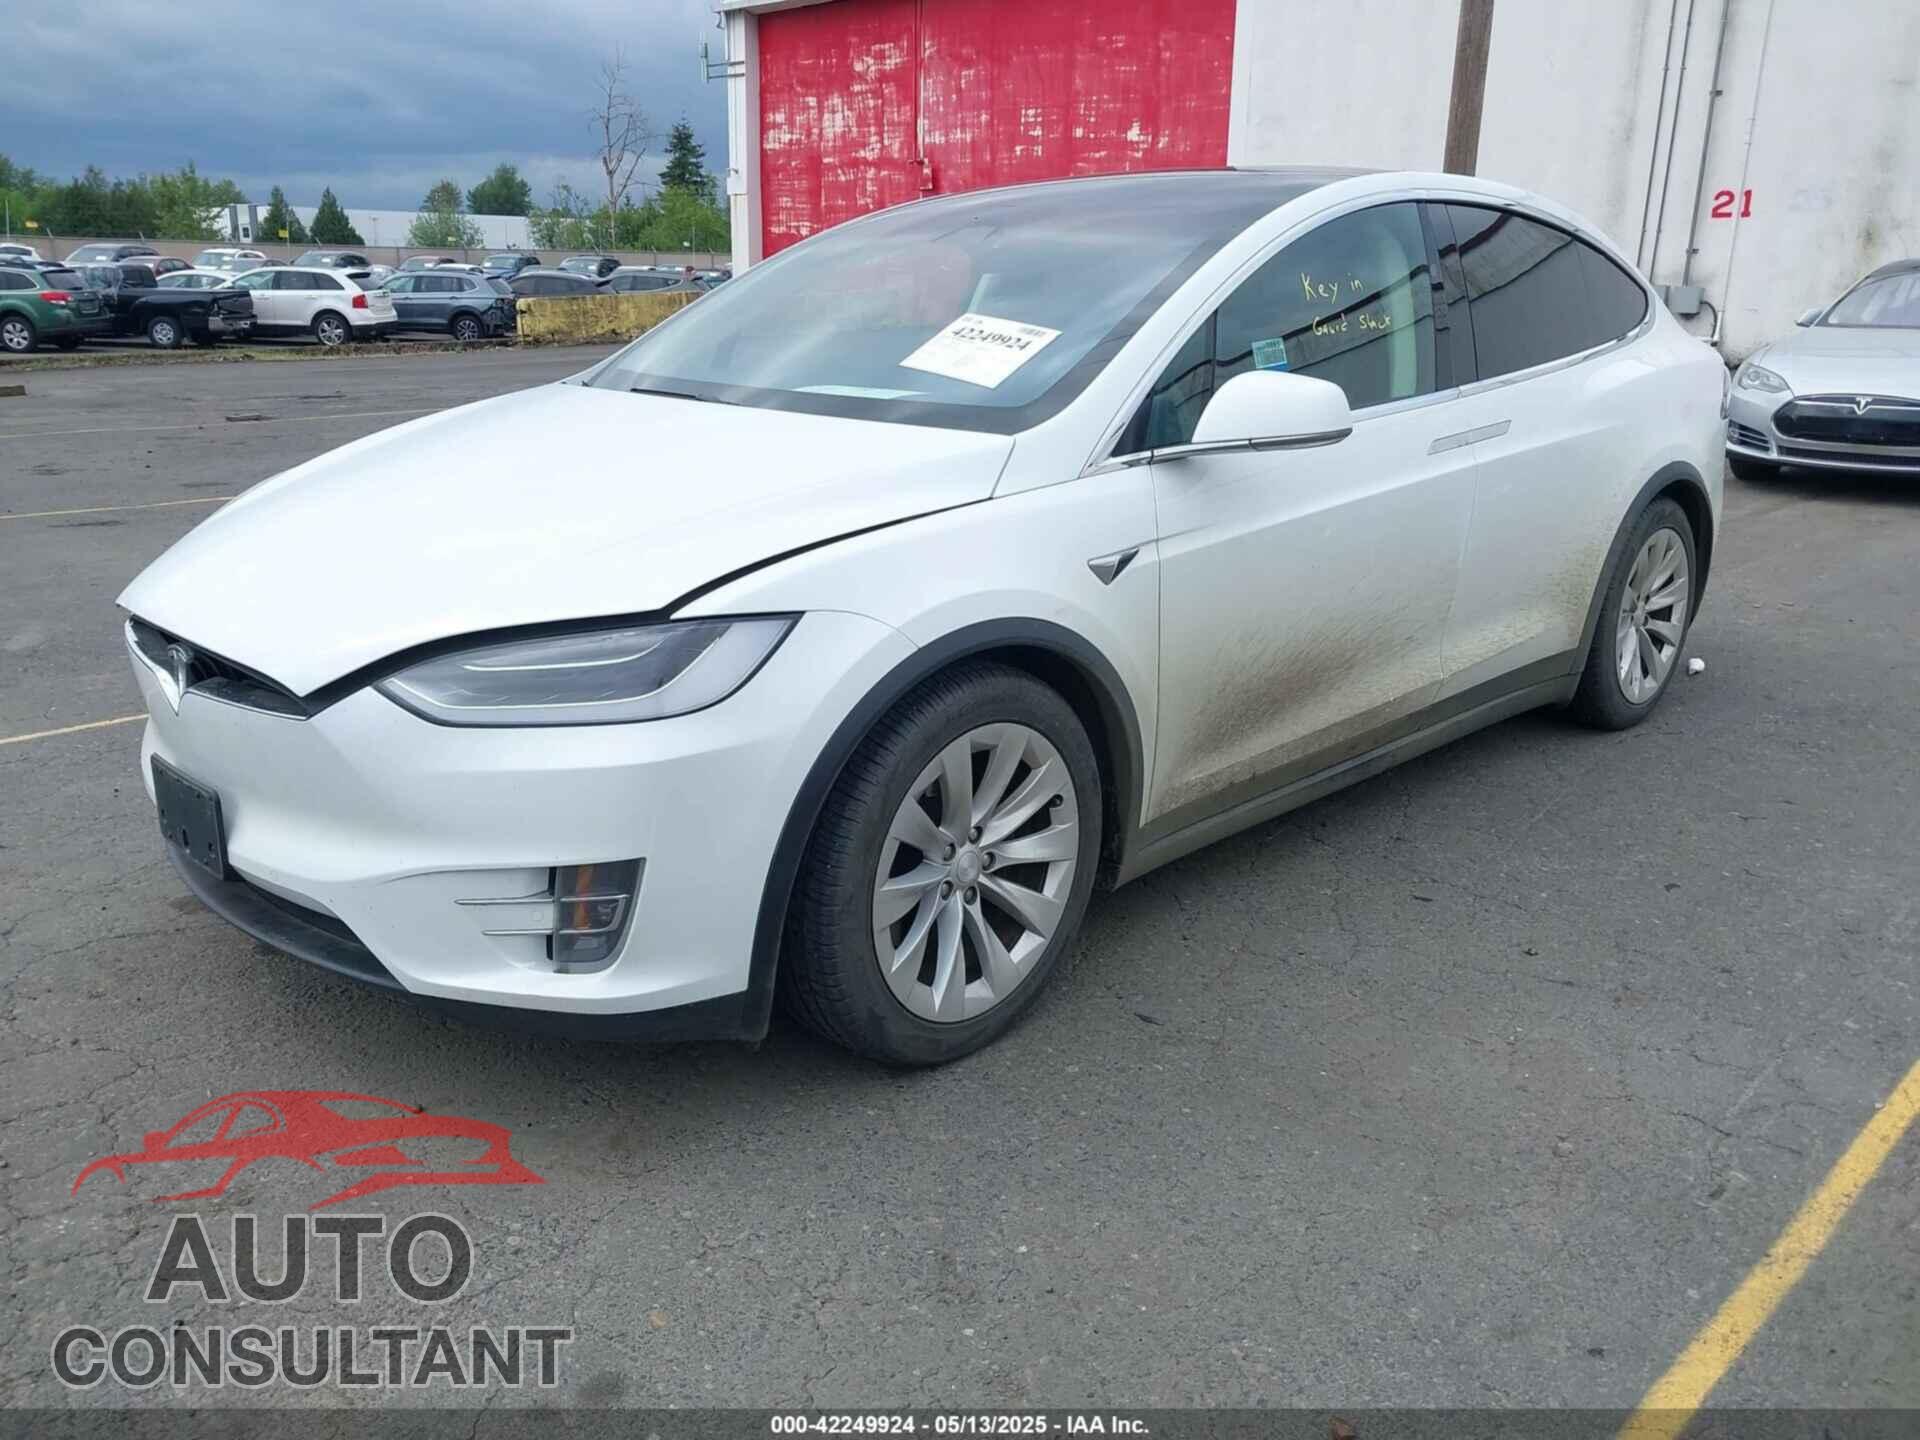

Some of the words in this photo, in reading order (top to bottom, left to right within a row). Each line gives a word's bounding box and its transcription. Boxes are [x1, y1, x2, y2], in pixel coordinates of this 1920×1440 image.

[1711, 189, 1753, 219] 21
[1301, 272, 1338, 304] Key
[1347, 272, 1364, 292] in
[952, 326, 1032, 350] 42249924
